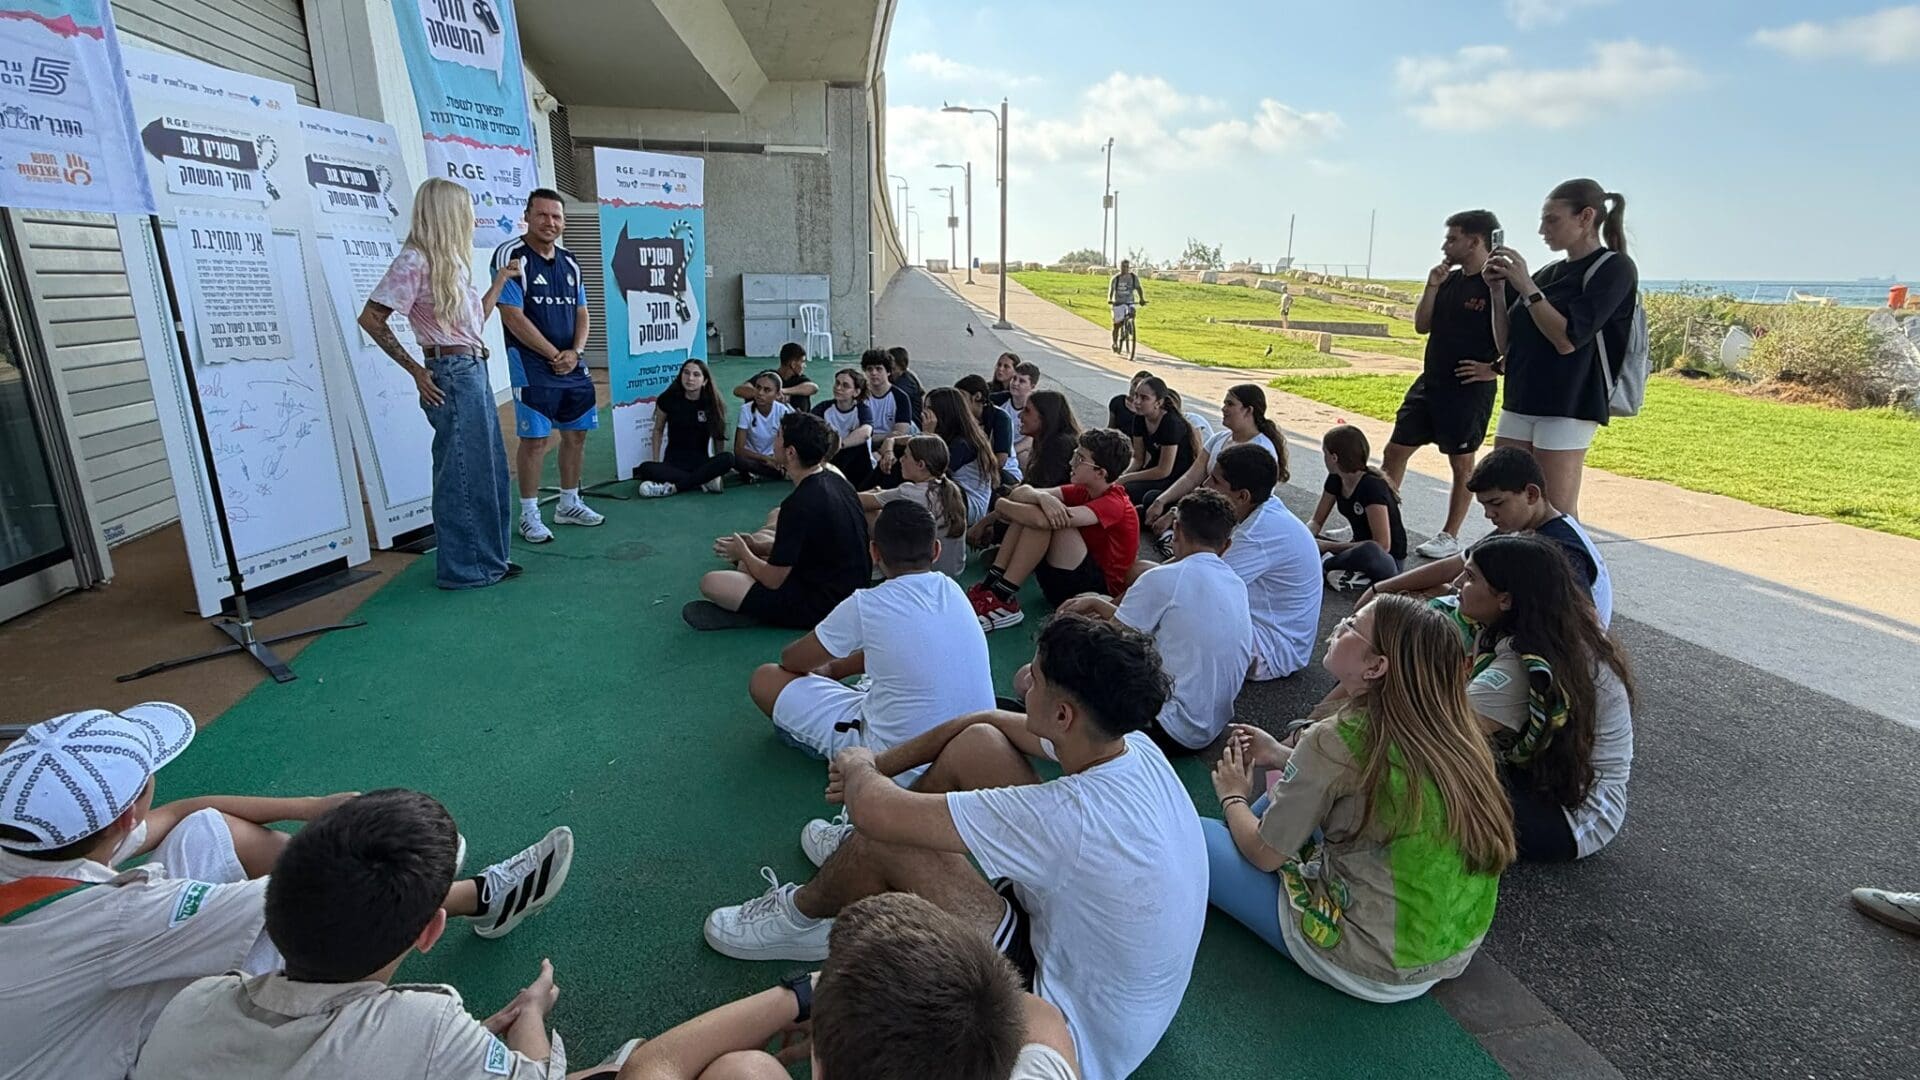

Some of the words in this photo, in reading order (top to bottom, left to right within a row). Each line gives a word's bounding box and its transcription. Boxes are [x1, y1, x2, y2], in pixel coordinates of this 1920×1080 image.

[434, 0, 467, 23] חוק
[426, 17, 485, 55] המשחק
[474, 118, 488, 131] את
[181, 136, 200, 155] את
[201, 139, 241, 162] משנים
[179, 165, 224, 188] המשחק
[226, 171, 252, 192] חוקי
[639, 247, 674, 266] משנים
[650, 268, 665, 287] את
[531, 296, 576, 305] VOLV
[647, 301, 670, 323] חוקי
[639, 323, 679, 346] המשחק
